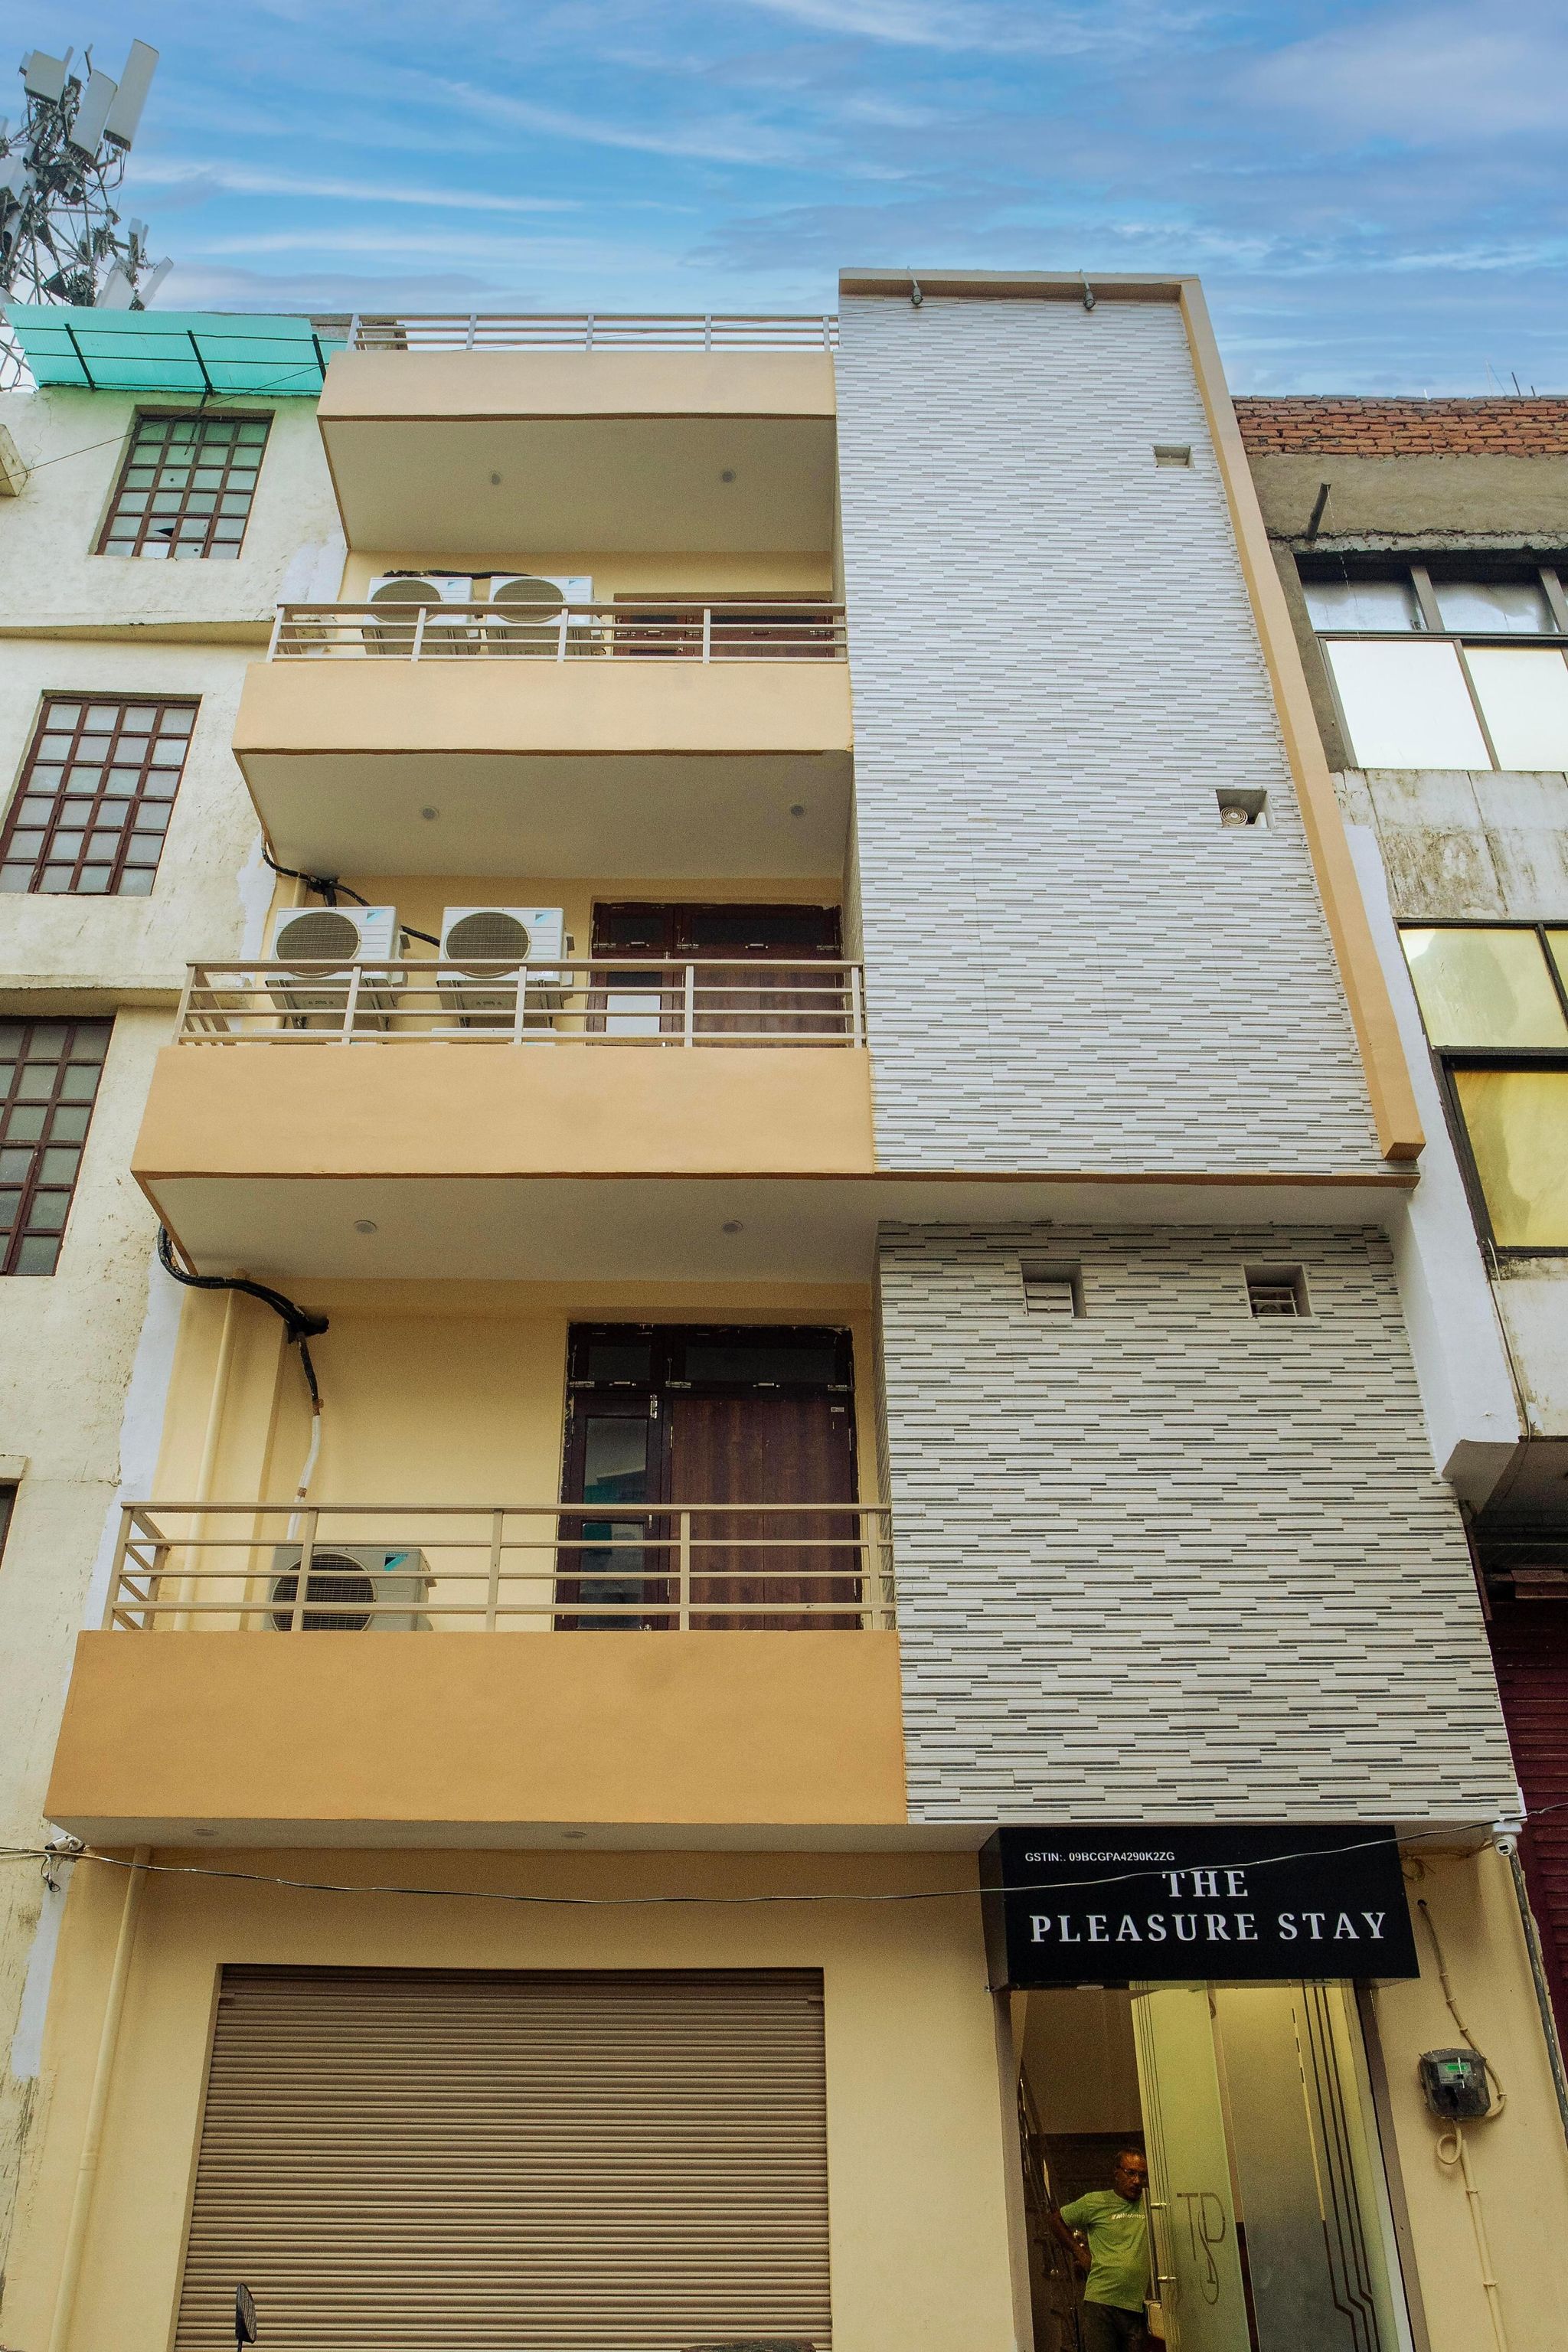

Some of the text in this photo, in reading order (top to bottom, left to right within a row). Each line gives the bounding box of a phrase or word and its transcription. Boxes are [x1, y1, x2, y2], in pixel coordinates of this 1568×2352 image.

[1068, 1851, 1175, 1862] 09BCGPA4290K2ZG
[1161, 1870, 1249, 1897] THE
[1029, 1912, 1386, 1942] PLEASURE STAY
